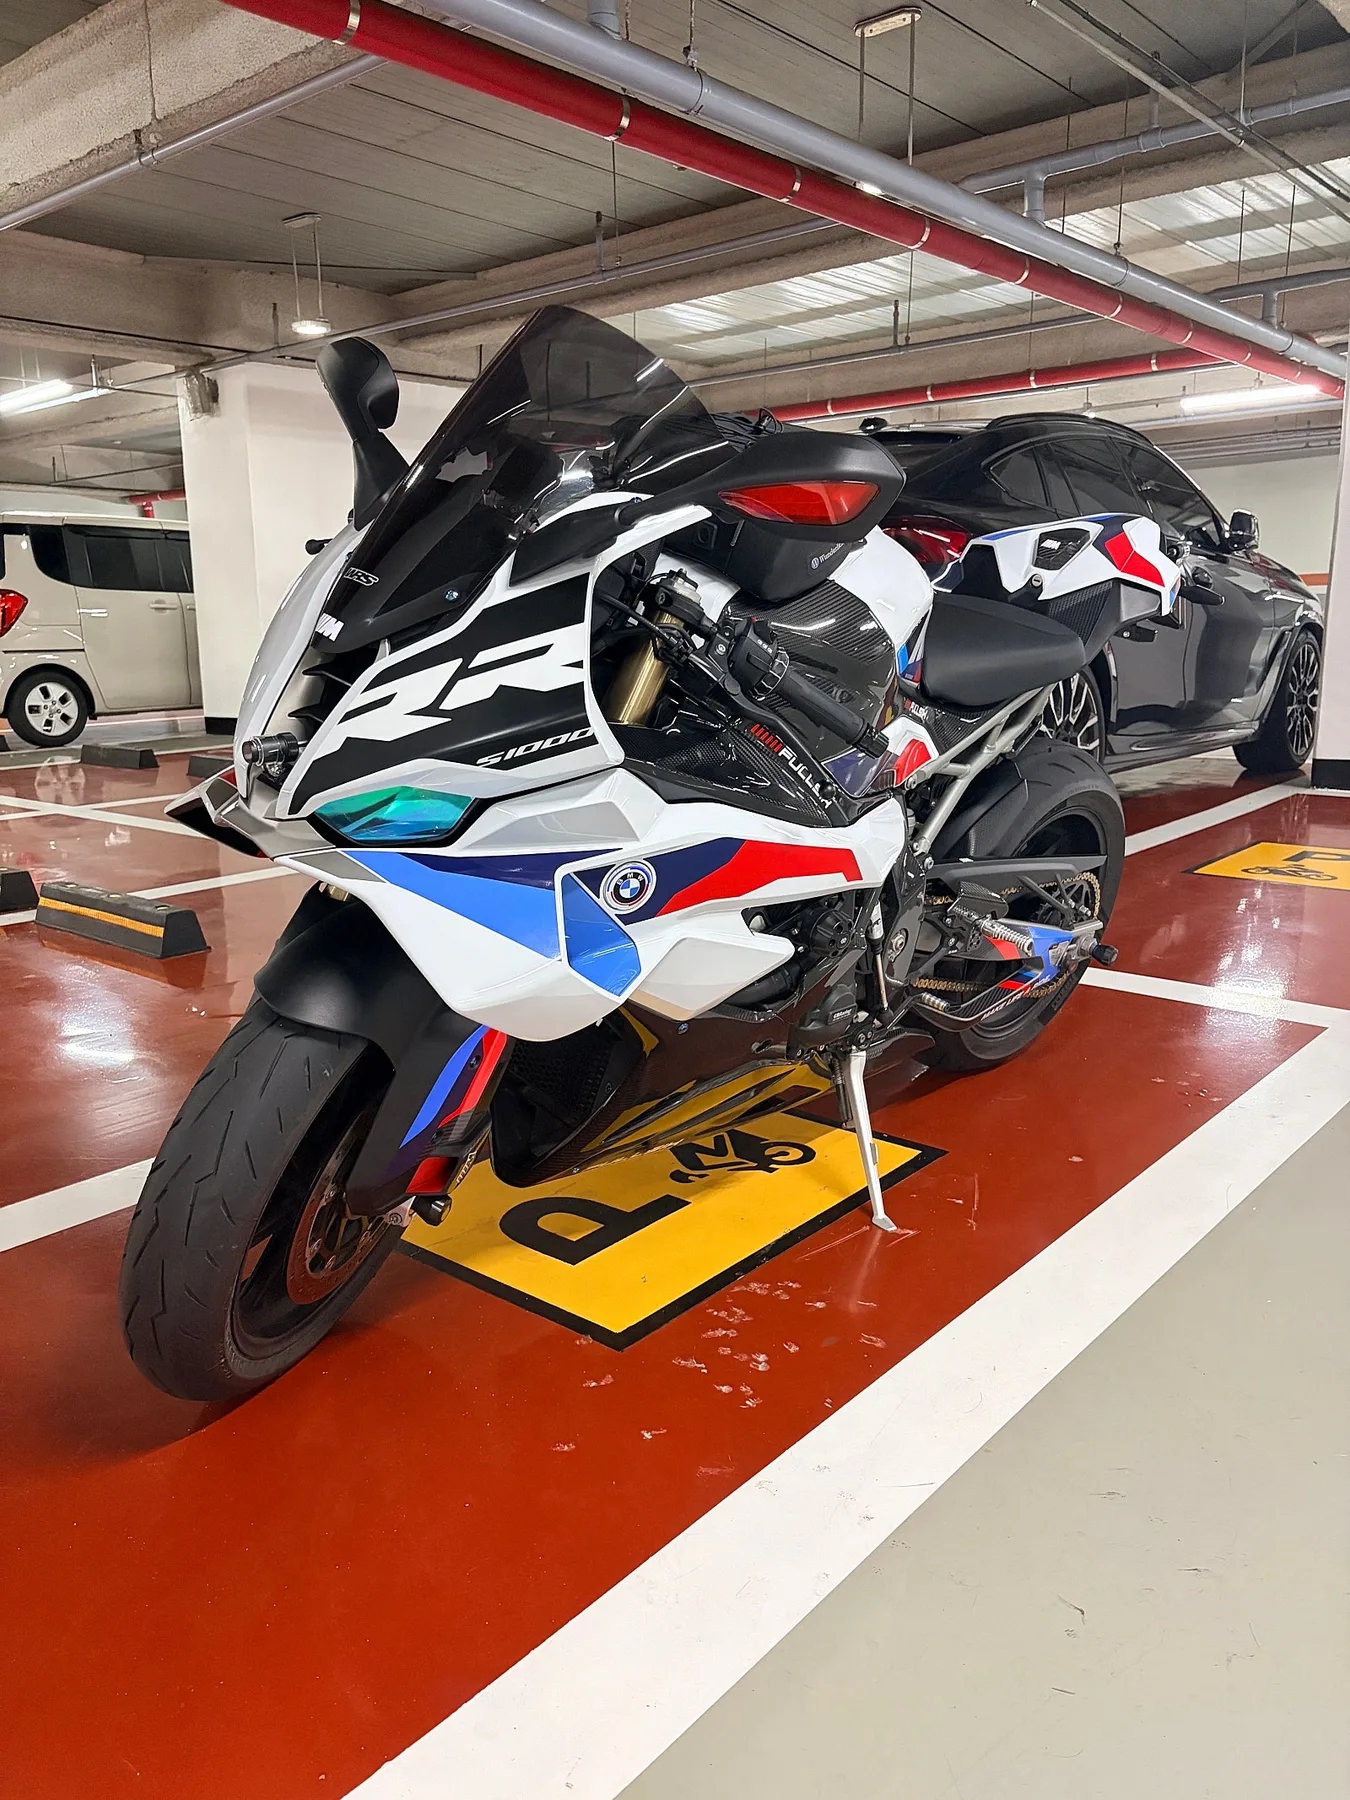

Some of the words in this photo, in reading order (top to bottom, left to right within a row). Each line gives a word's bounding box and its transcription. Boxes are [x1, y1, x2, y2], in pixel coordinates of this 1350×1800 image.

[476, 727, 596, 768] S1000
[778, 747, 833, 809] FULLSX
[616, 872, 645, 886] BMW
[499, 1194, 692, 1266] P
